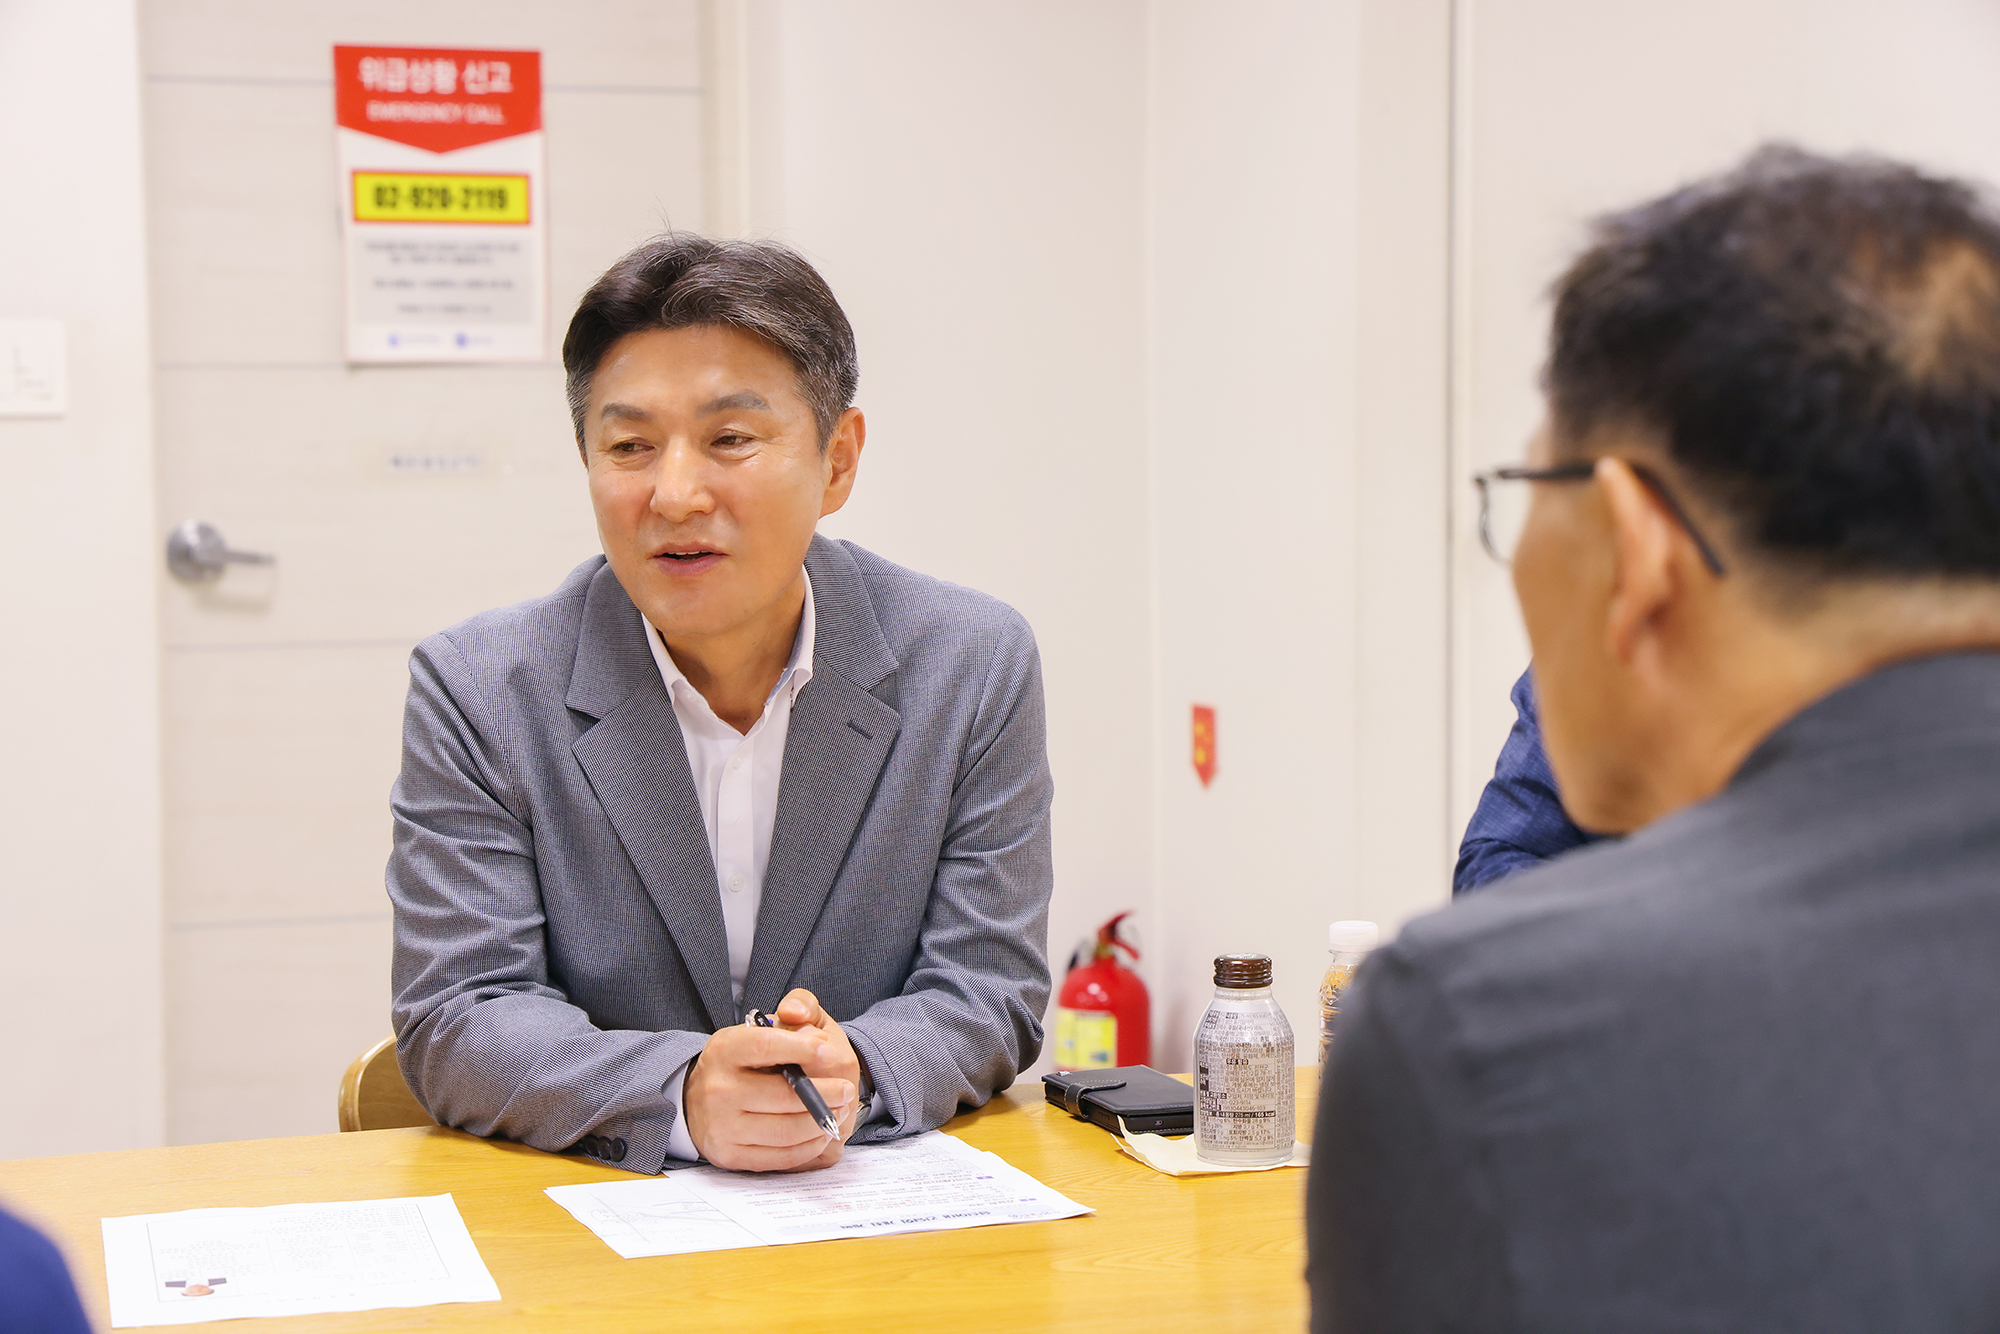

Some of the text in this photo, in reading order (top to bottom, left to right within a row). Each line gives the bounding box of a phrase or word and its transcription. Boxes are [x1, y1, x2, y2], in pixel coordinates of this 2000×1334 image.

[358, 56, 513, 94] 위급상황 신고
[366, 100, 505, 125] EMERGENCY CALL
